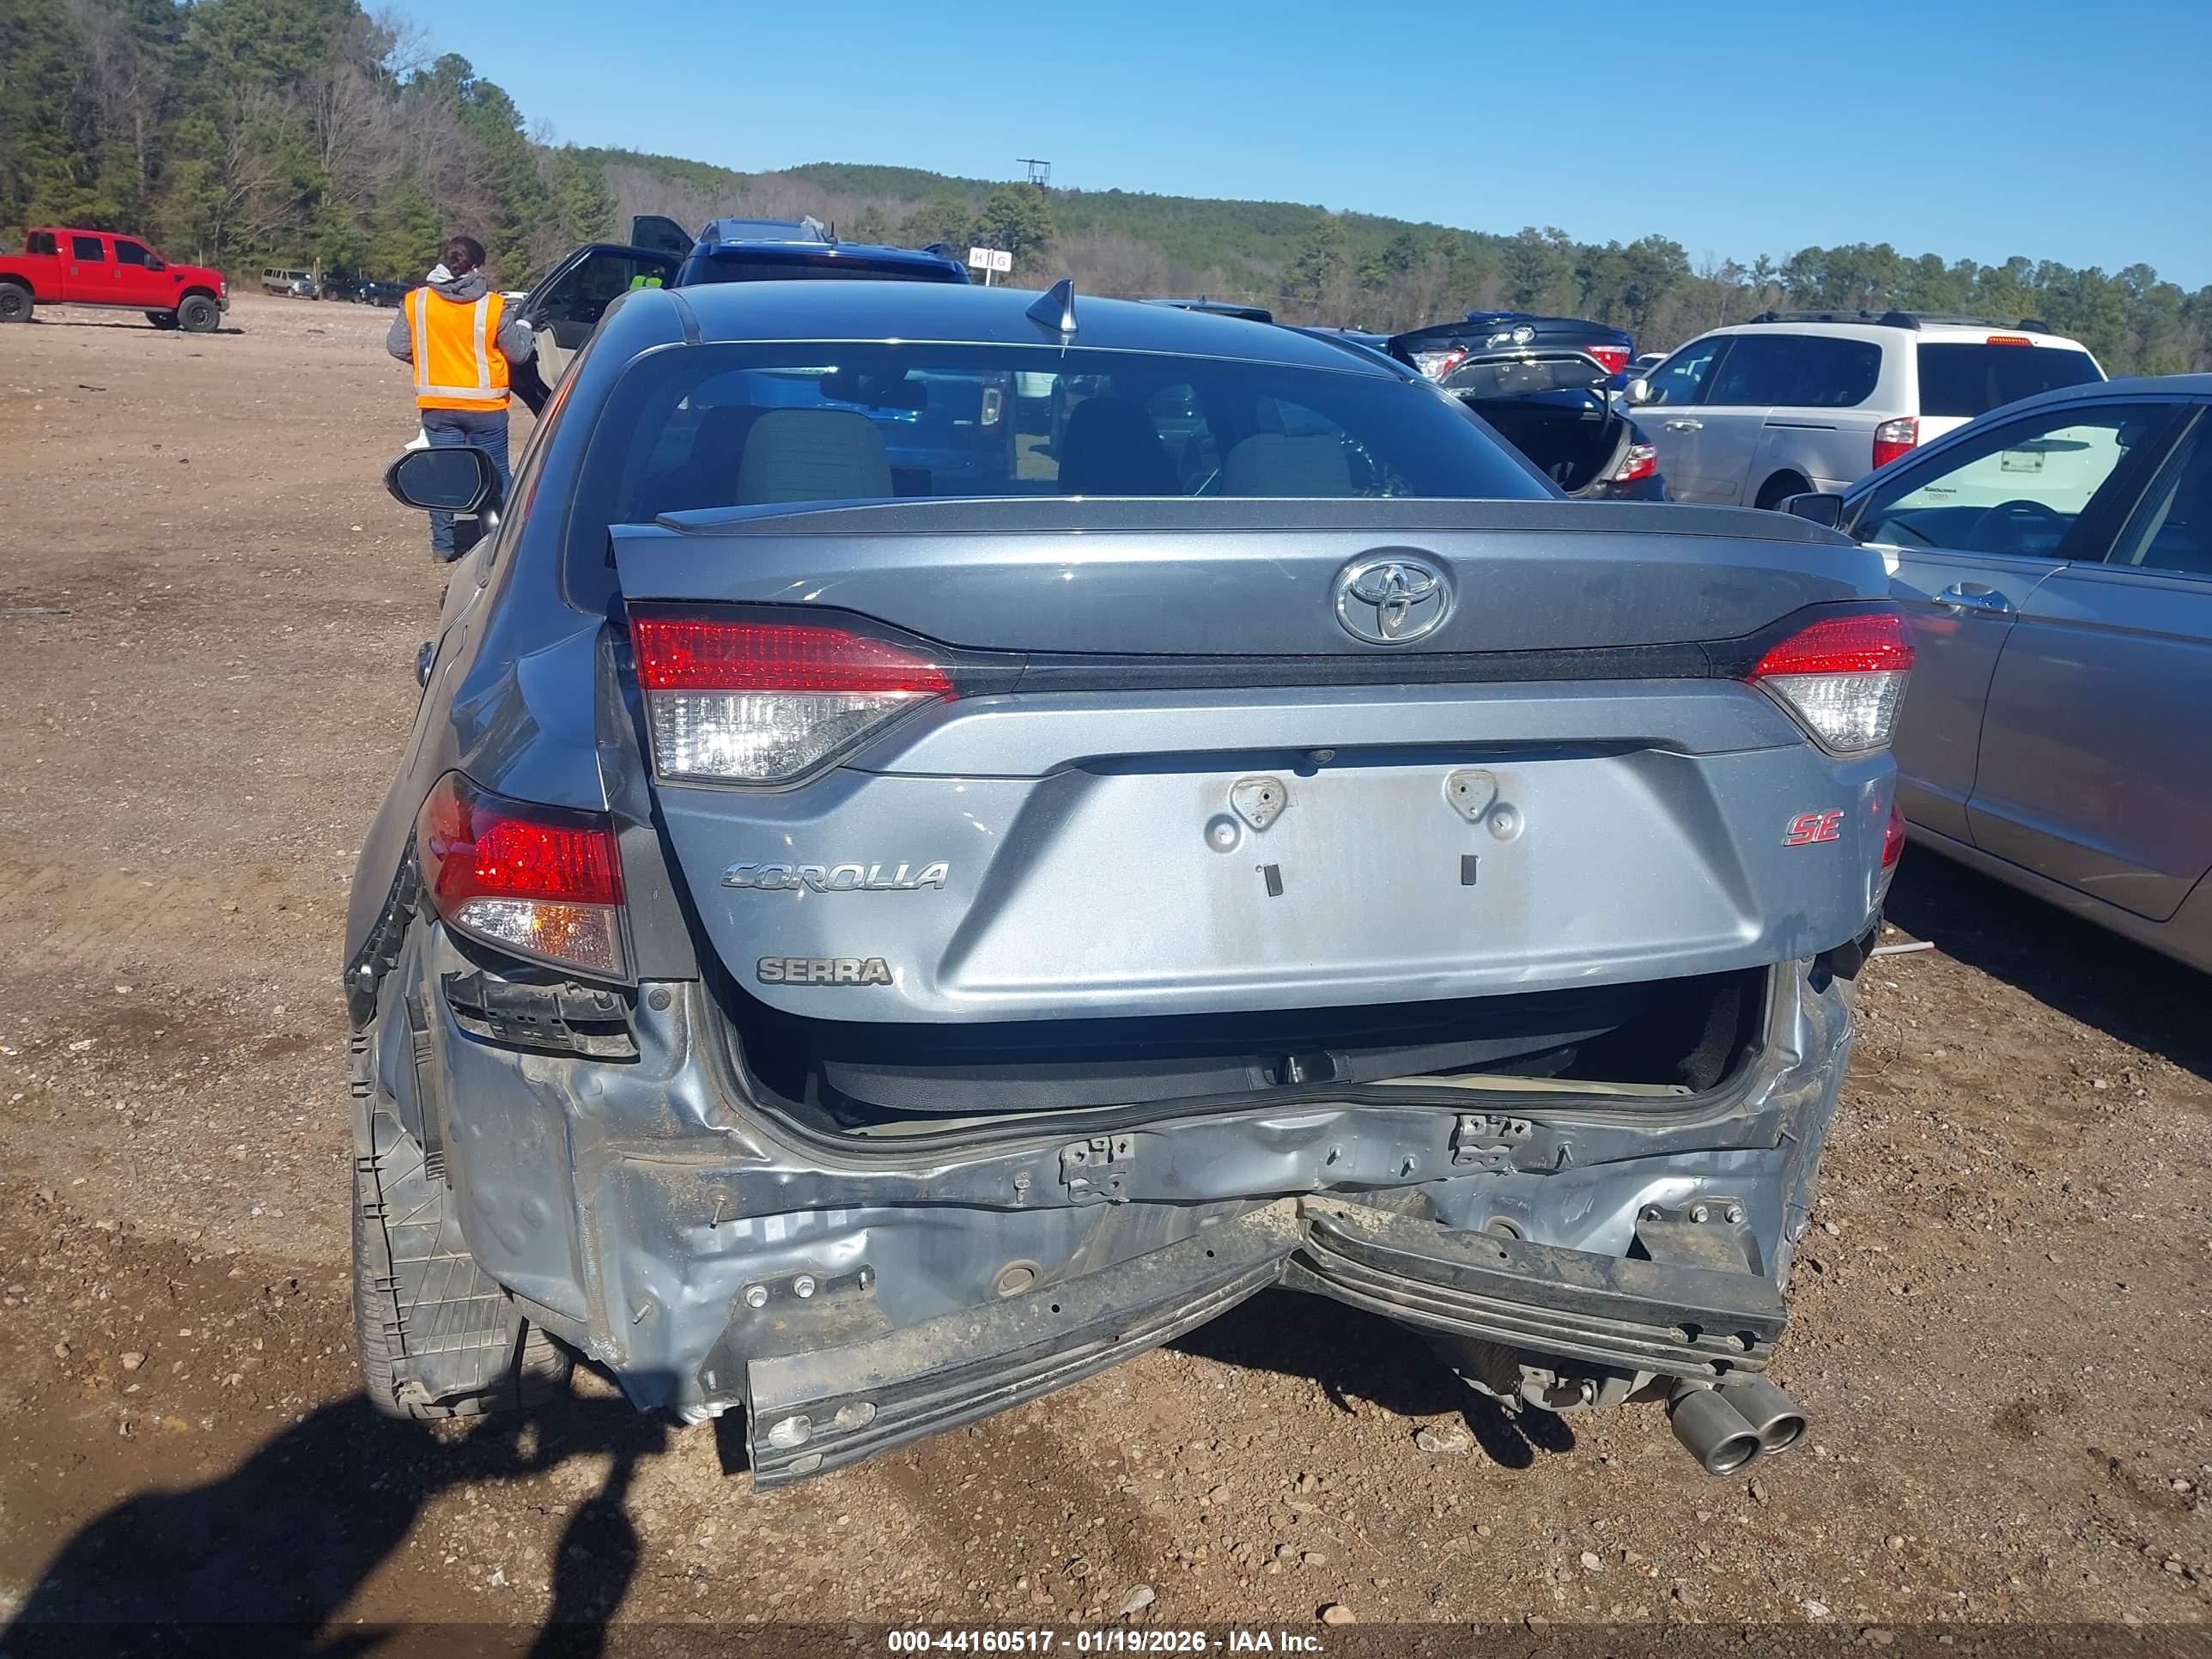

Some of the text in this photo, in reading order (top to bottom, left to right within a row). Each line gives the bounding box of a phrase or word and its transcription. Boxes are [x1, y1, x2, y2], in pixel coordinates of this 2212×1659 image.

[974, 252, 983, 263] H
[997, 256, 1006, 266] G
[1782, 809, 1844, 846] SE
[721, 860, 949, 893] COROLLA
[757, 957, 893, 985] SERRA
